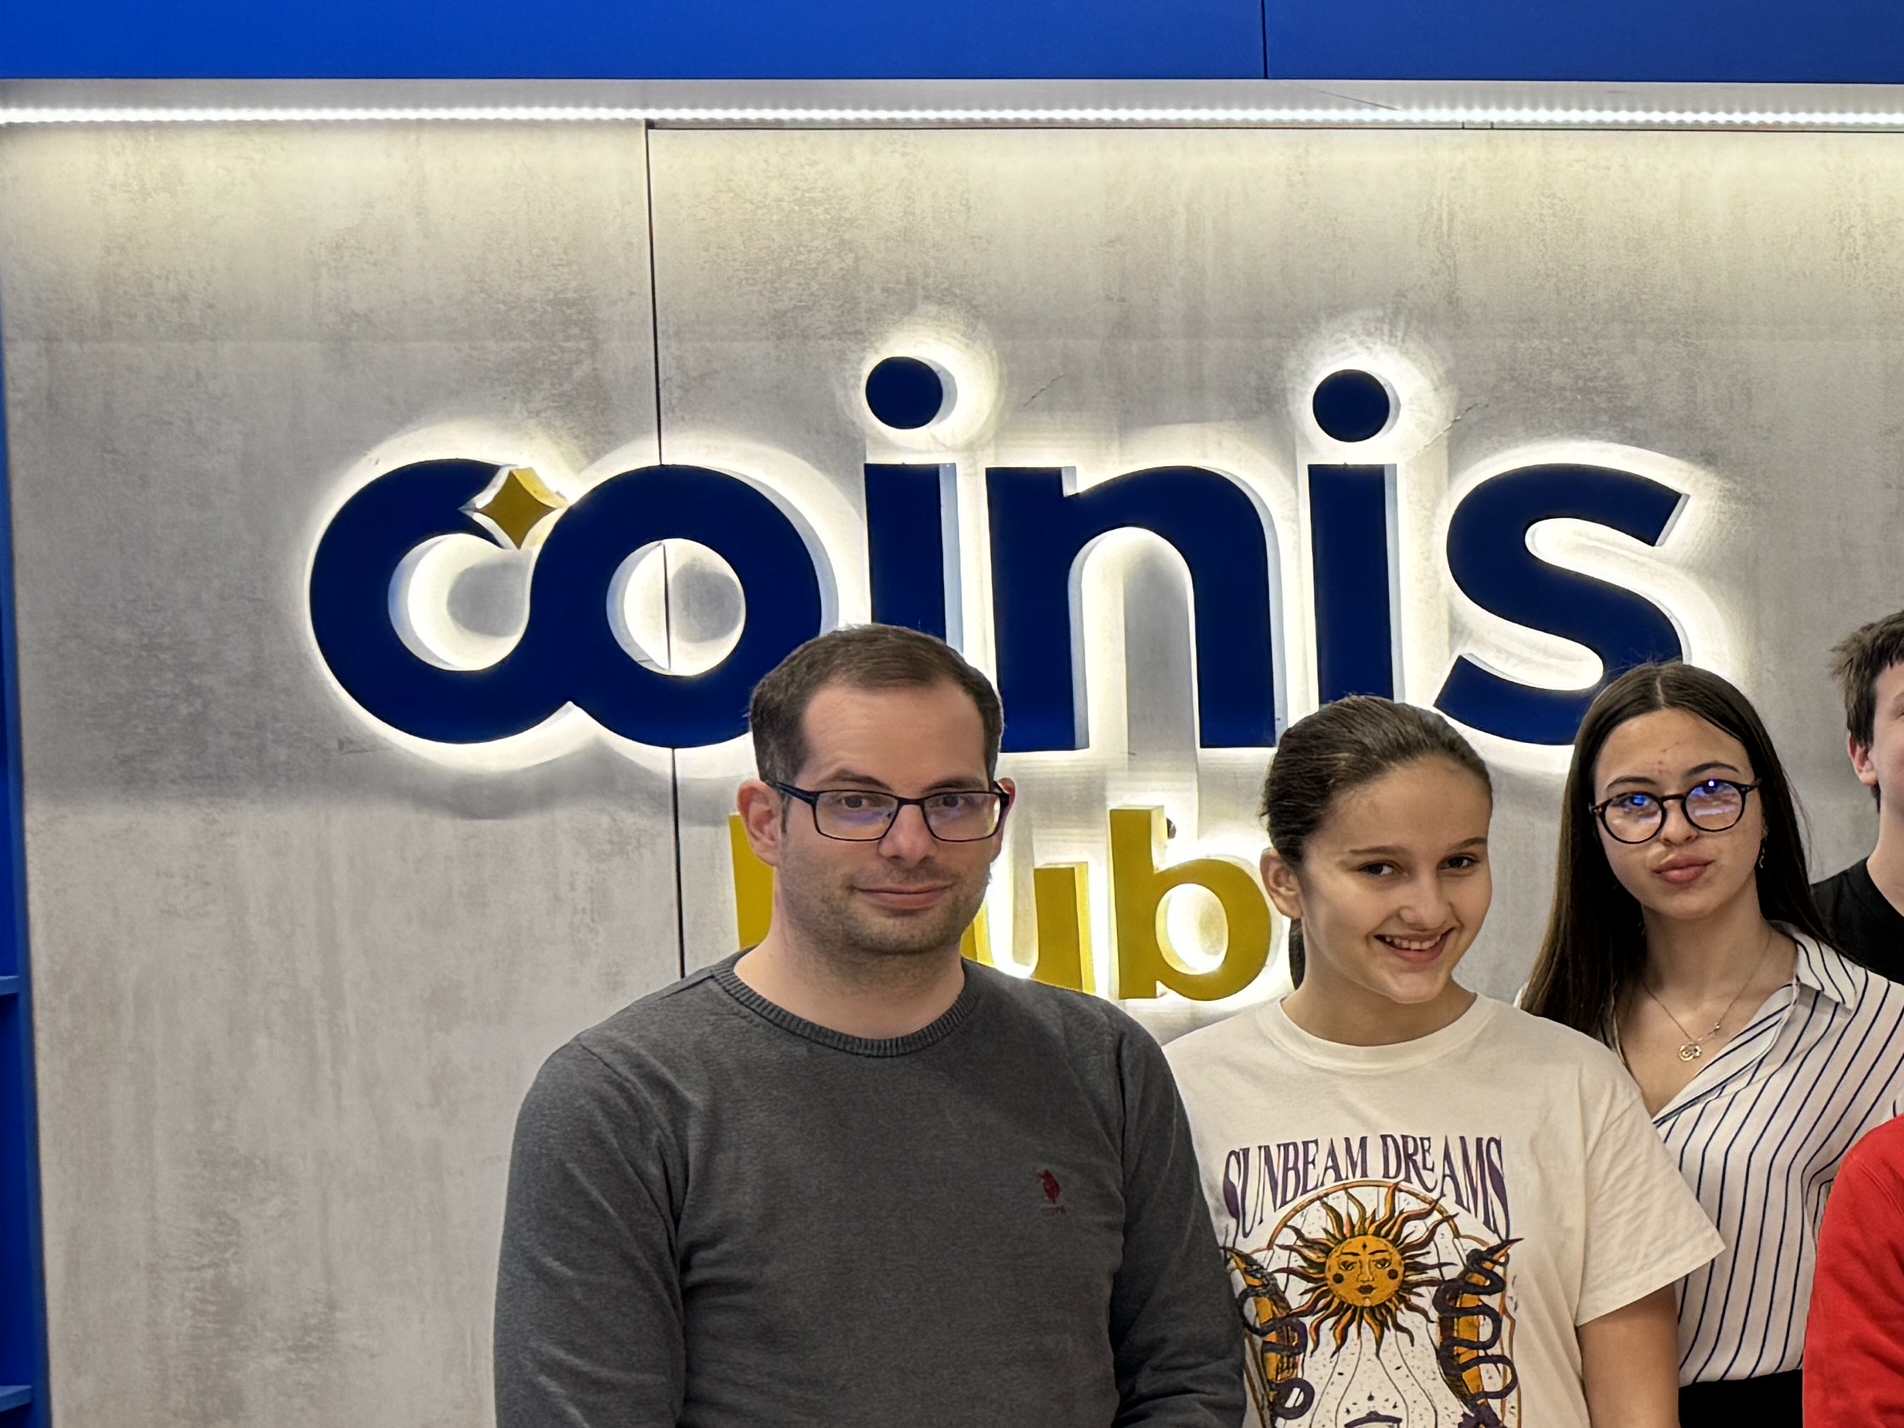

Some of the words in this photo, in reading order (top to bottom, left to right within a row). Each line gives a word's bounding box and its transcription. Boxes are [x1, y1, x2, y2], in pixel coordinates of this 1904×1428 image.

[308, 355, 1692, 750] coinis
[728, 806, 1271, 1000] ub
[1223, 1136, 1369, 1239] SUNBEAM
[1380, 1133, 1511, 1240] DREAMS
